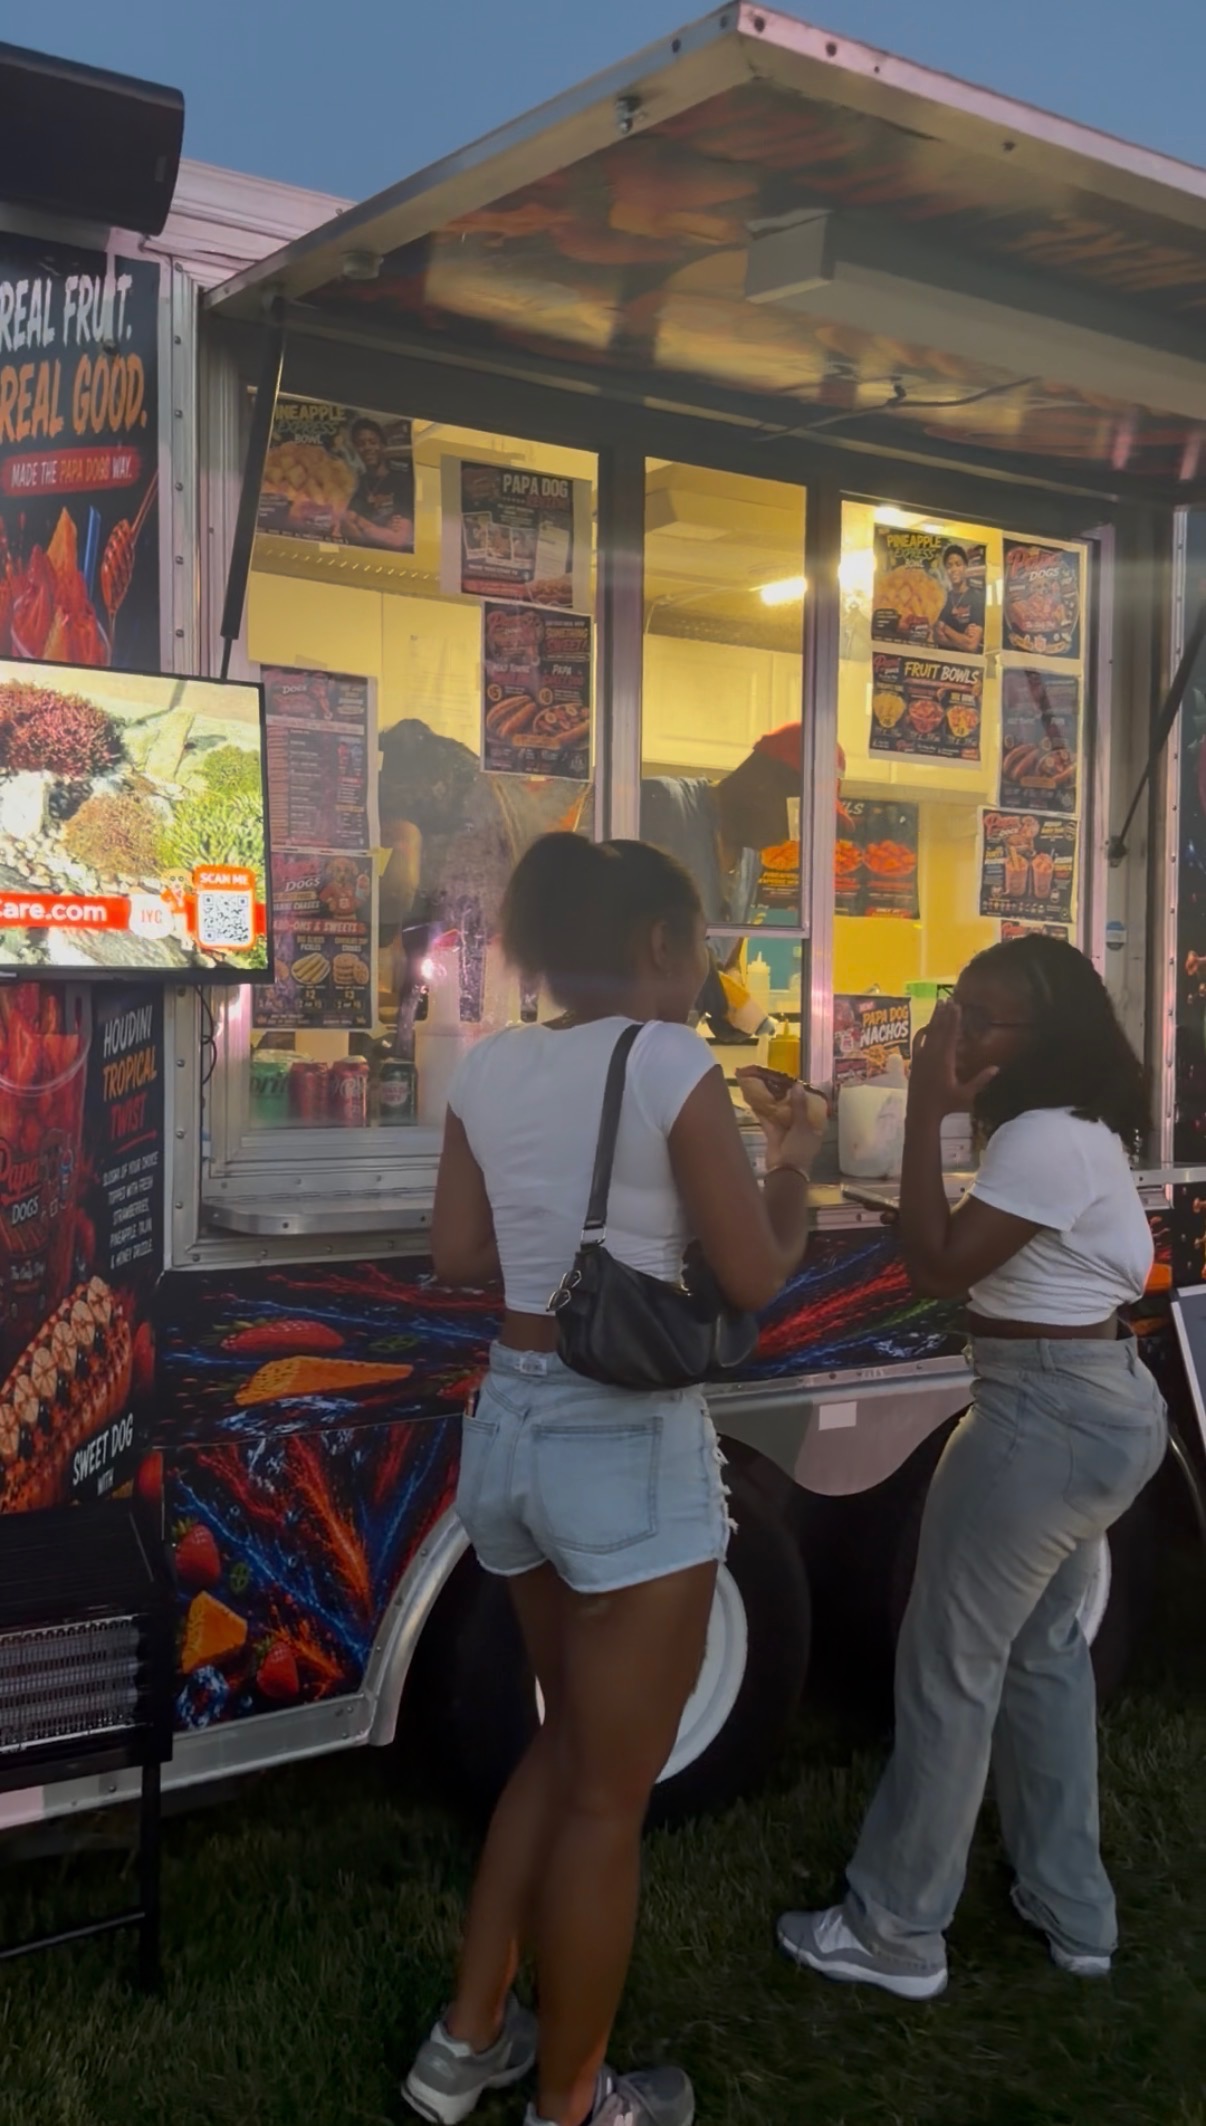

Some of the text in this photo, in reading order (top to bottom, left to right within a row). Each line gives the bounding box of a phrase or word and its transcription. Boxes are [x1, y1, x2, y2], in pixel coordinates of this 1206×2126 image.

[0, 273, 132, 353] REAL FRUT.
[0, 352, 147, 444] REAL GOOD.
[274, 404, 346, 420] INEAPPLE
[11, 462, 38, 488] MADE
[41, 460, 58, 485] THE
[60, 458, 83, 484] PAPA
[503, 474, 540, 496] PAPA
[541, 478, 569, 498] DOG
[887, 534, 942, 548] PINEAPPLE
[1029, 566, 1060, 582] DOGS
[904, 661, 980, 684] FRUIT BOWLS
[200, 872, 249, 885] SCAN ME
[284, 876, 321, 893] DOGS
[0, 901, 107, 922] are.com
[889, 1005, 909, 1022] DOG
[104, 1005, 153, 1058] HOUDINI
[860, 1020, 909, 1048] NACHOS
[103, 1045, 157, 1102] TROPICAL
[111, 1091, 147, 1141] TWIST
[12, 1195, 39, 1225] DOGS
[73, 1412, 134, 1486] SWEET DOG
